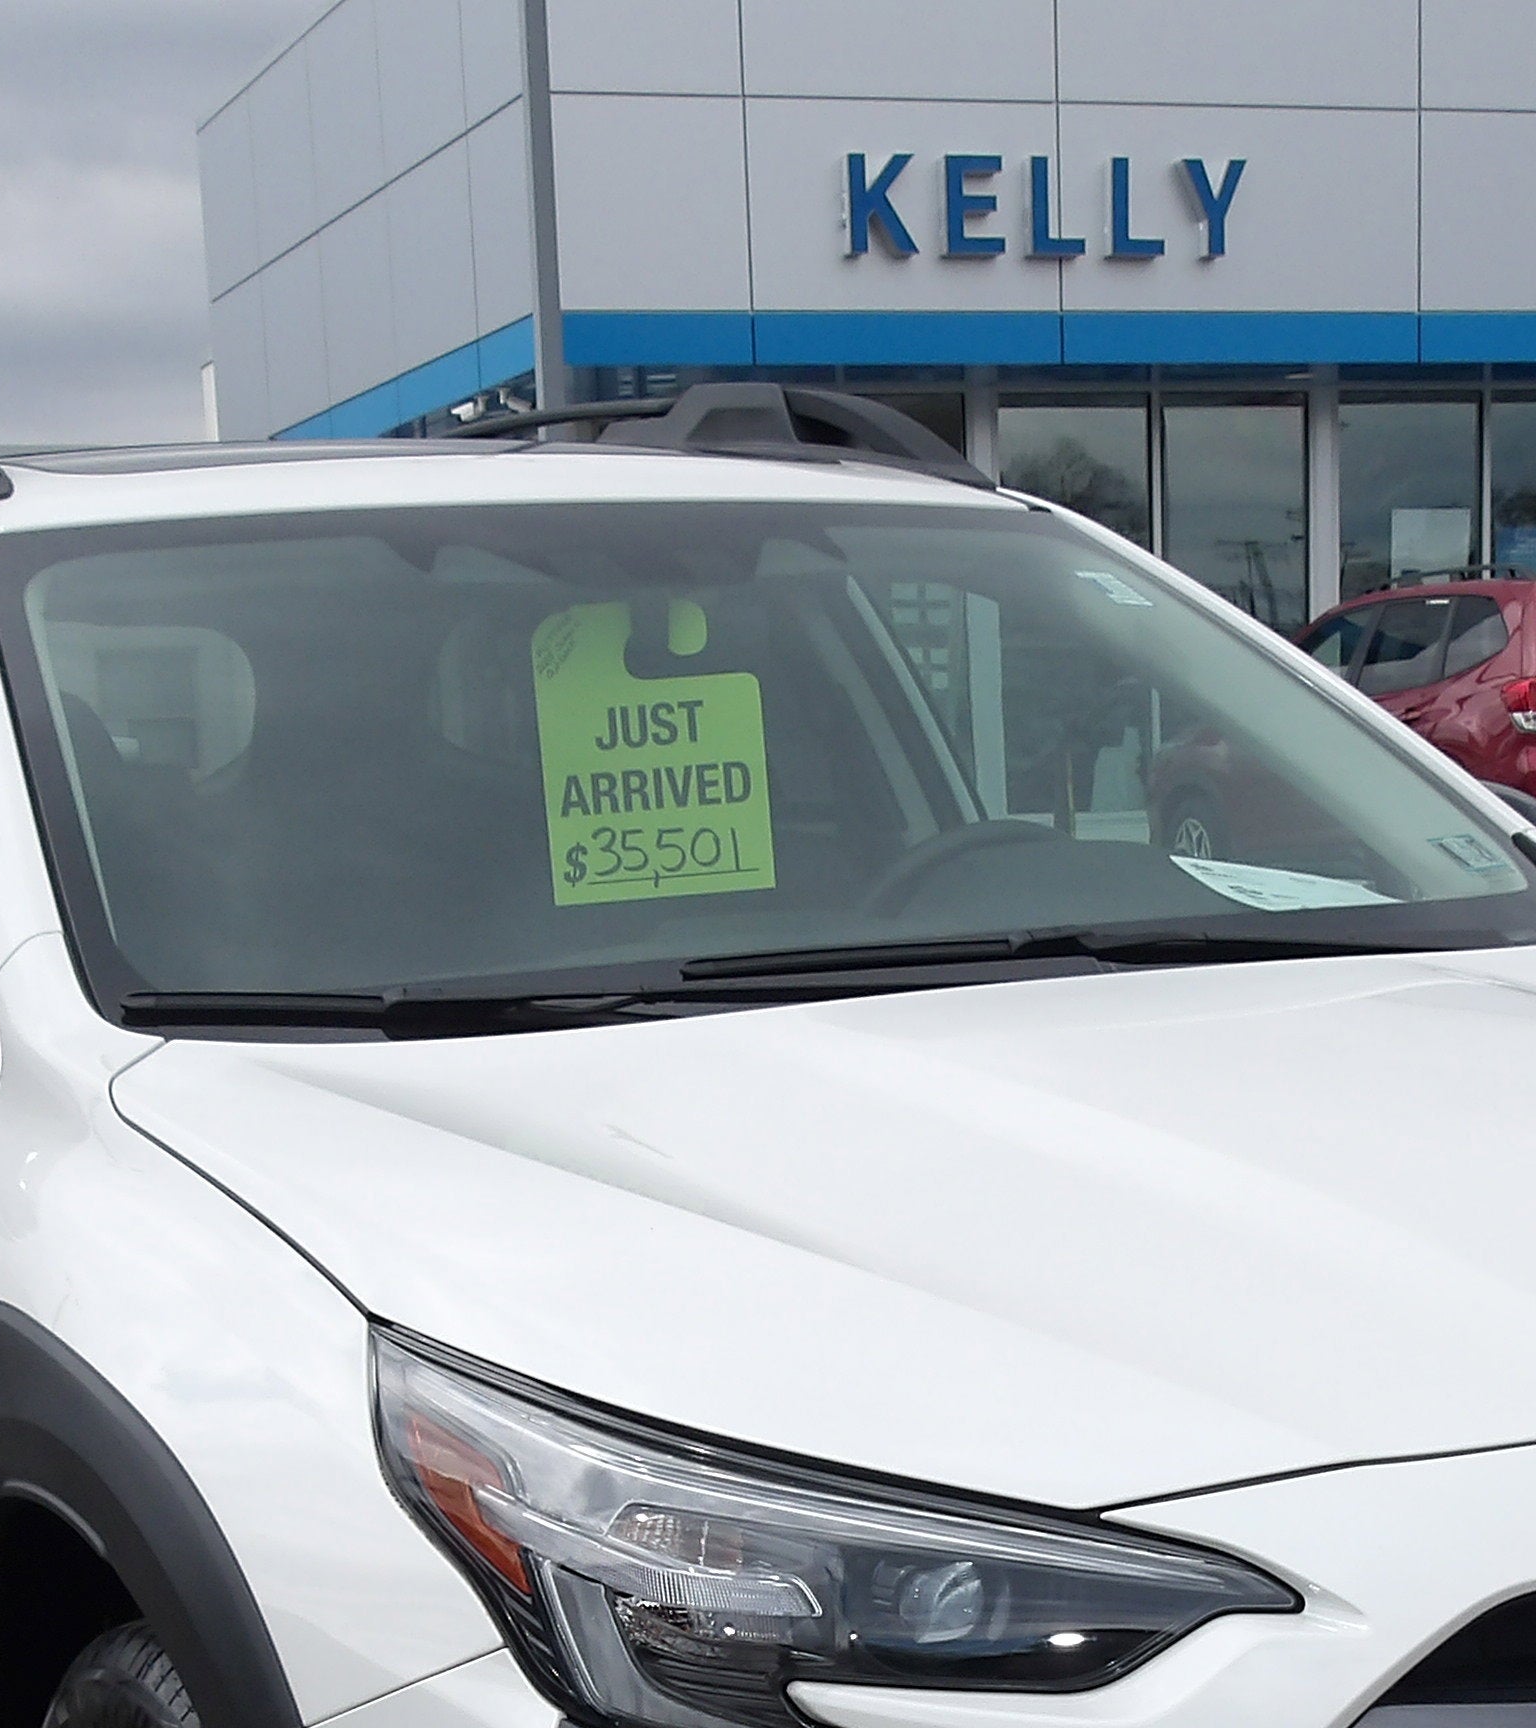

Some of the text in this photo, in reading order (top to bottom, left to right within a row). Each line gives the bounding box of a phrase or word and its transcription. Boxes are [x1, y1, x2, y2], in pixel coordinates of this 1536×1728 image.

[844, 152, 1247, 258] KELLY
[595, 700, 704, 751] JUST
[561, 761, 752, 817] ARRIVED
[564, 827, 740, 887] $35,501
